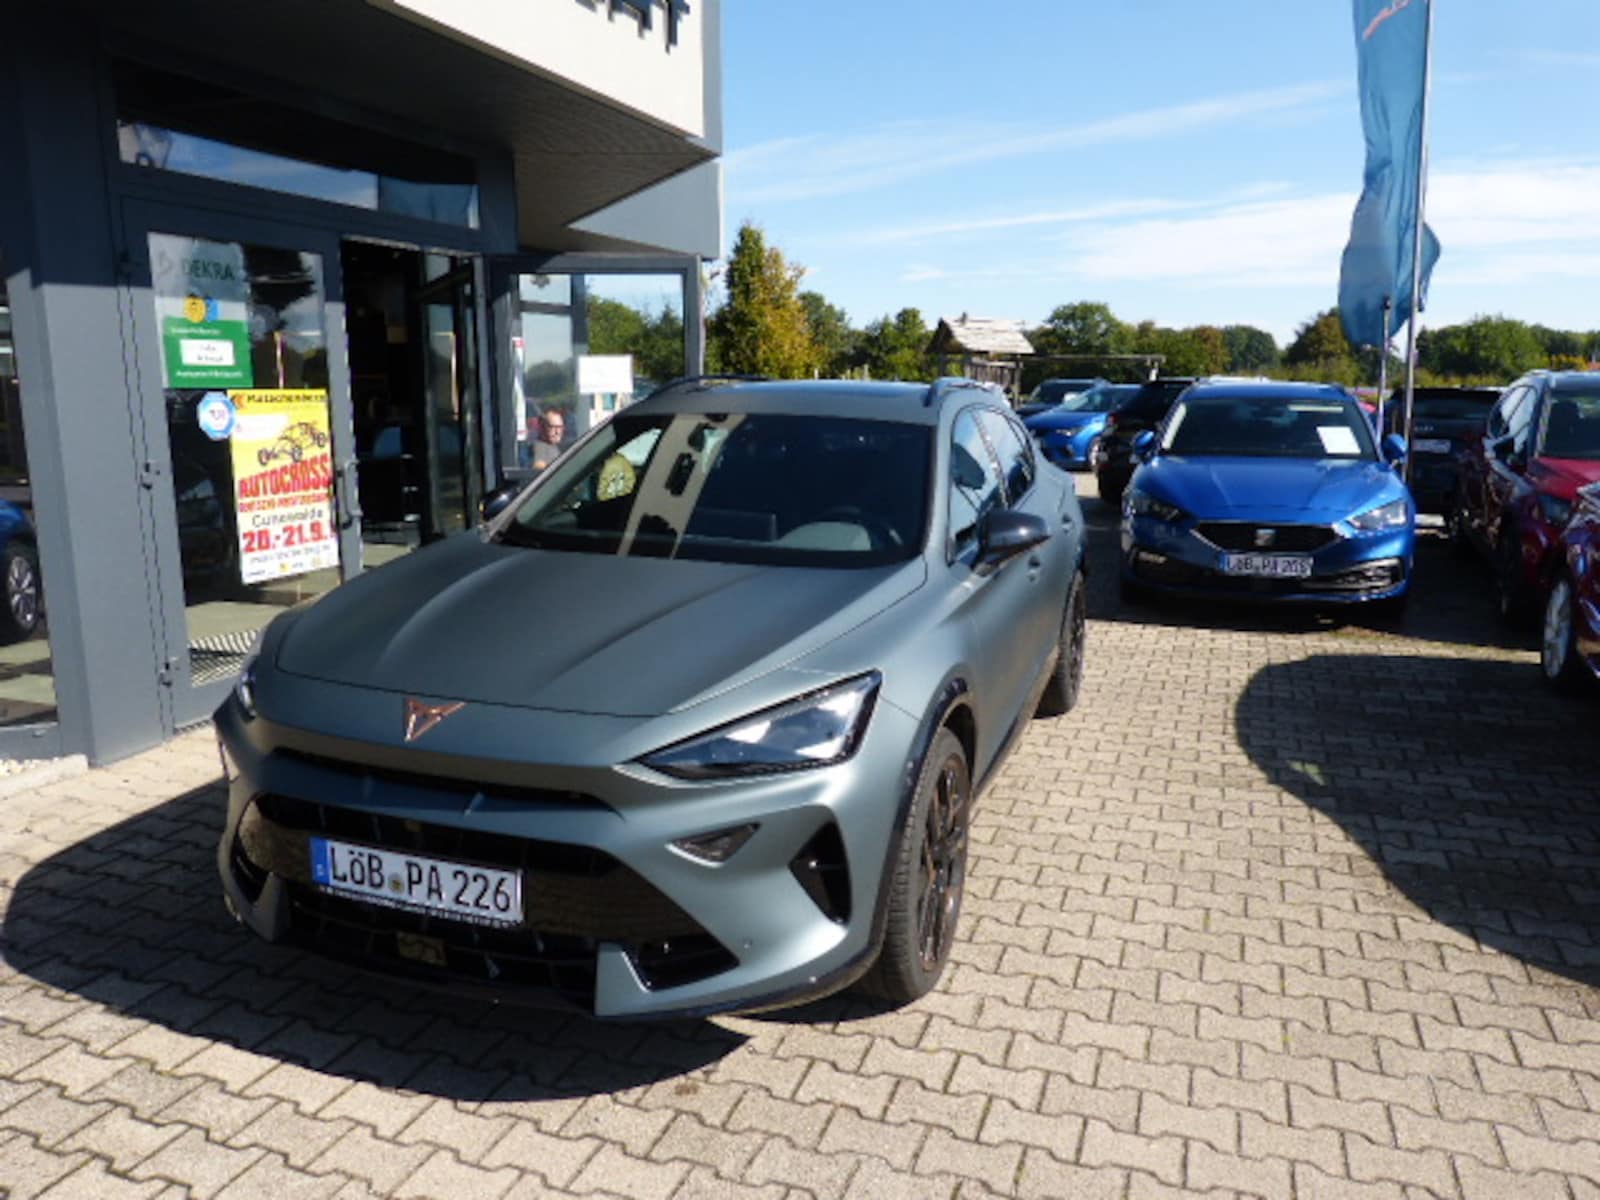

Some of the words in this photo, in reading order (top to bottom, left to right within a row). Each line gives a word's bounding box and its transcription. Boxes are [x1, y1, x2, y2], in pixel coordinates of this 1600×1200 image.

[238, 453, 332, 500] AUTOCROSS
[405, 859, 445, 902] PA
[452, 869, 512, 913] 226
